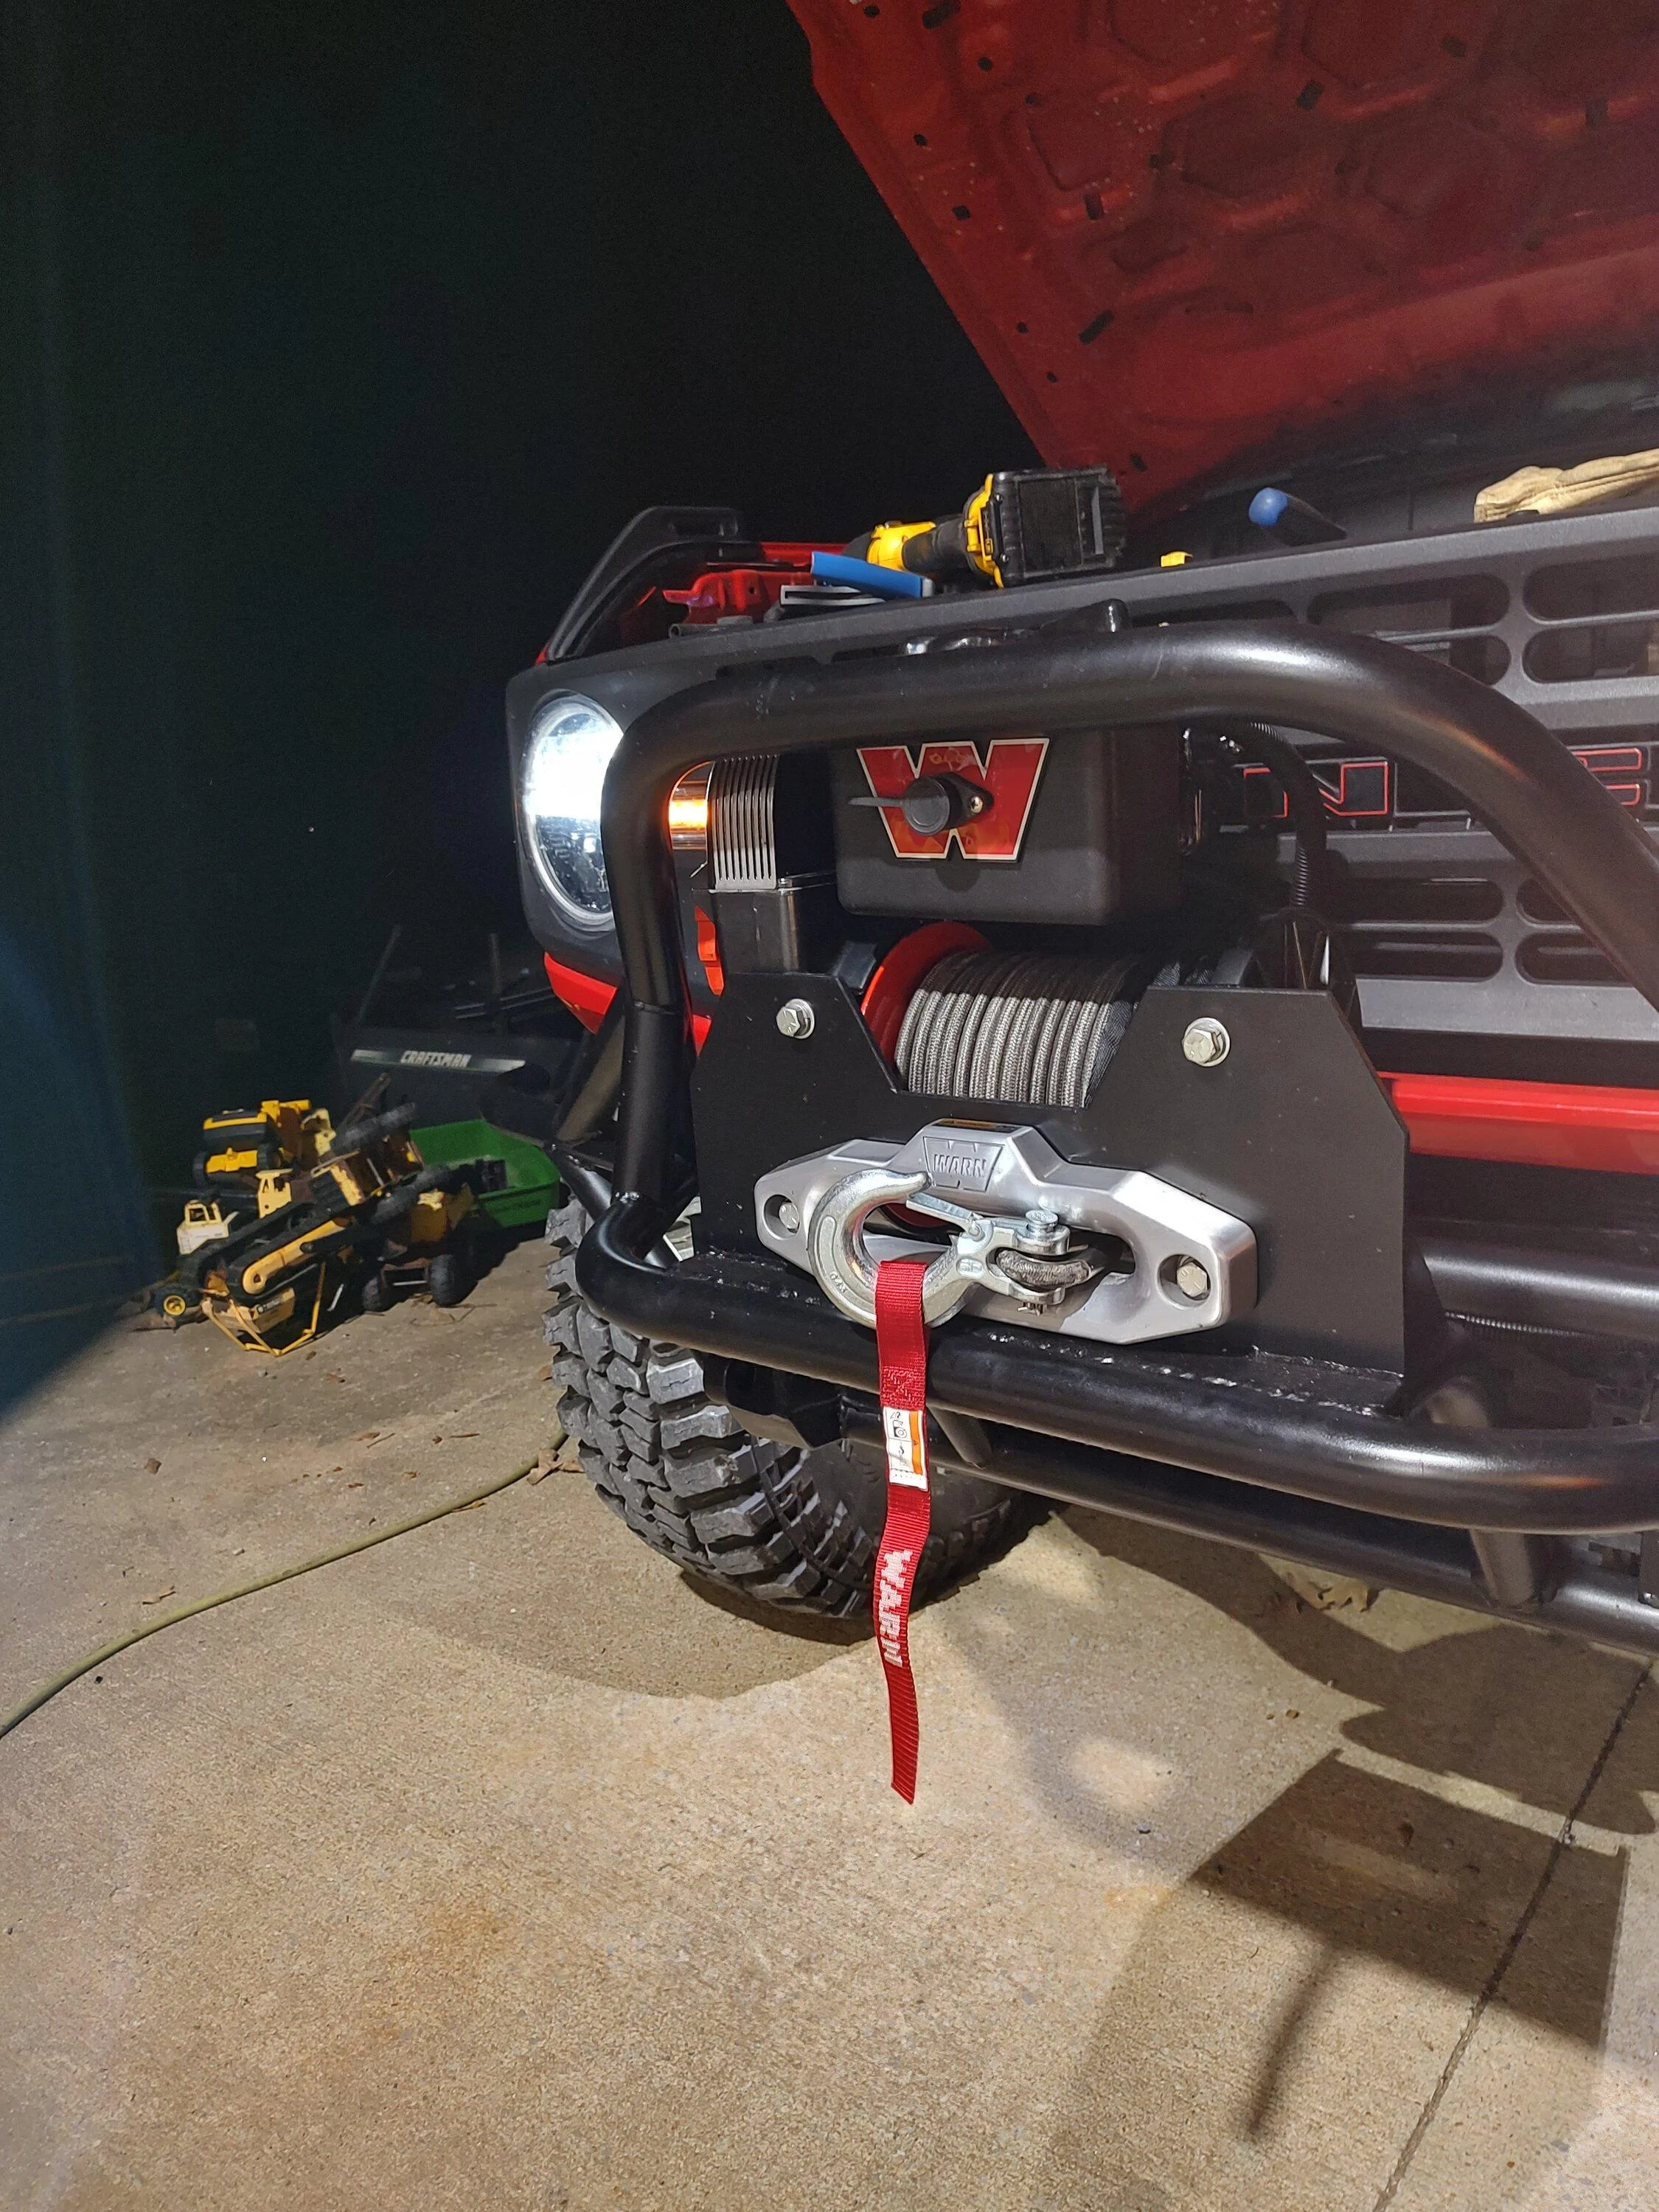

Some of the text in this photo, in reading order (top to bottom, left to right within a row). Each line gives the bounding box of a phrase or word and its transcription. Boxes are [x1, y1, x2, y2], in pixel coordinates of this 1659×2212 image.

[400, 1051, 471, 1068] CRAFTSMAN
[934, 1154, 987, 1178] WARN
[879, 1550, 914, 1668] WARN
